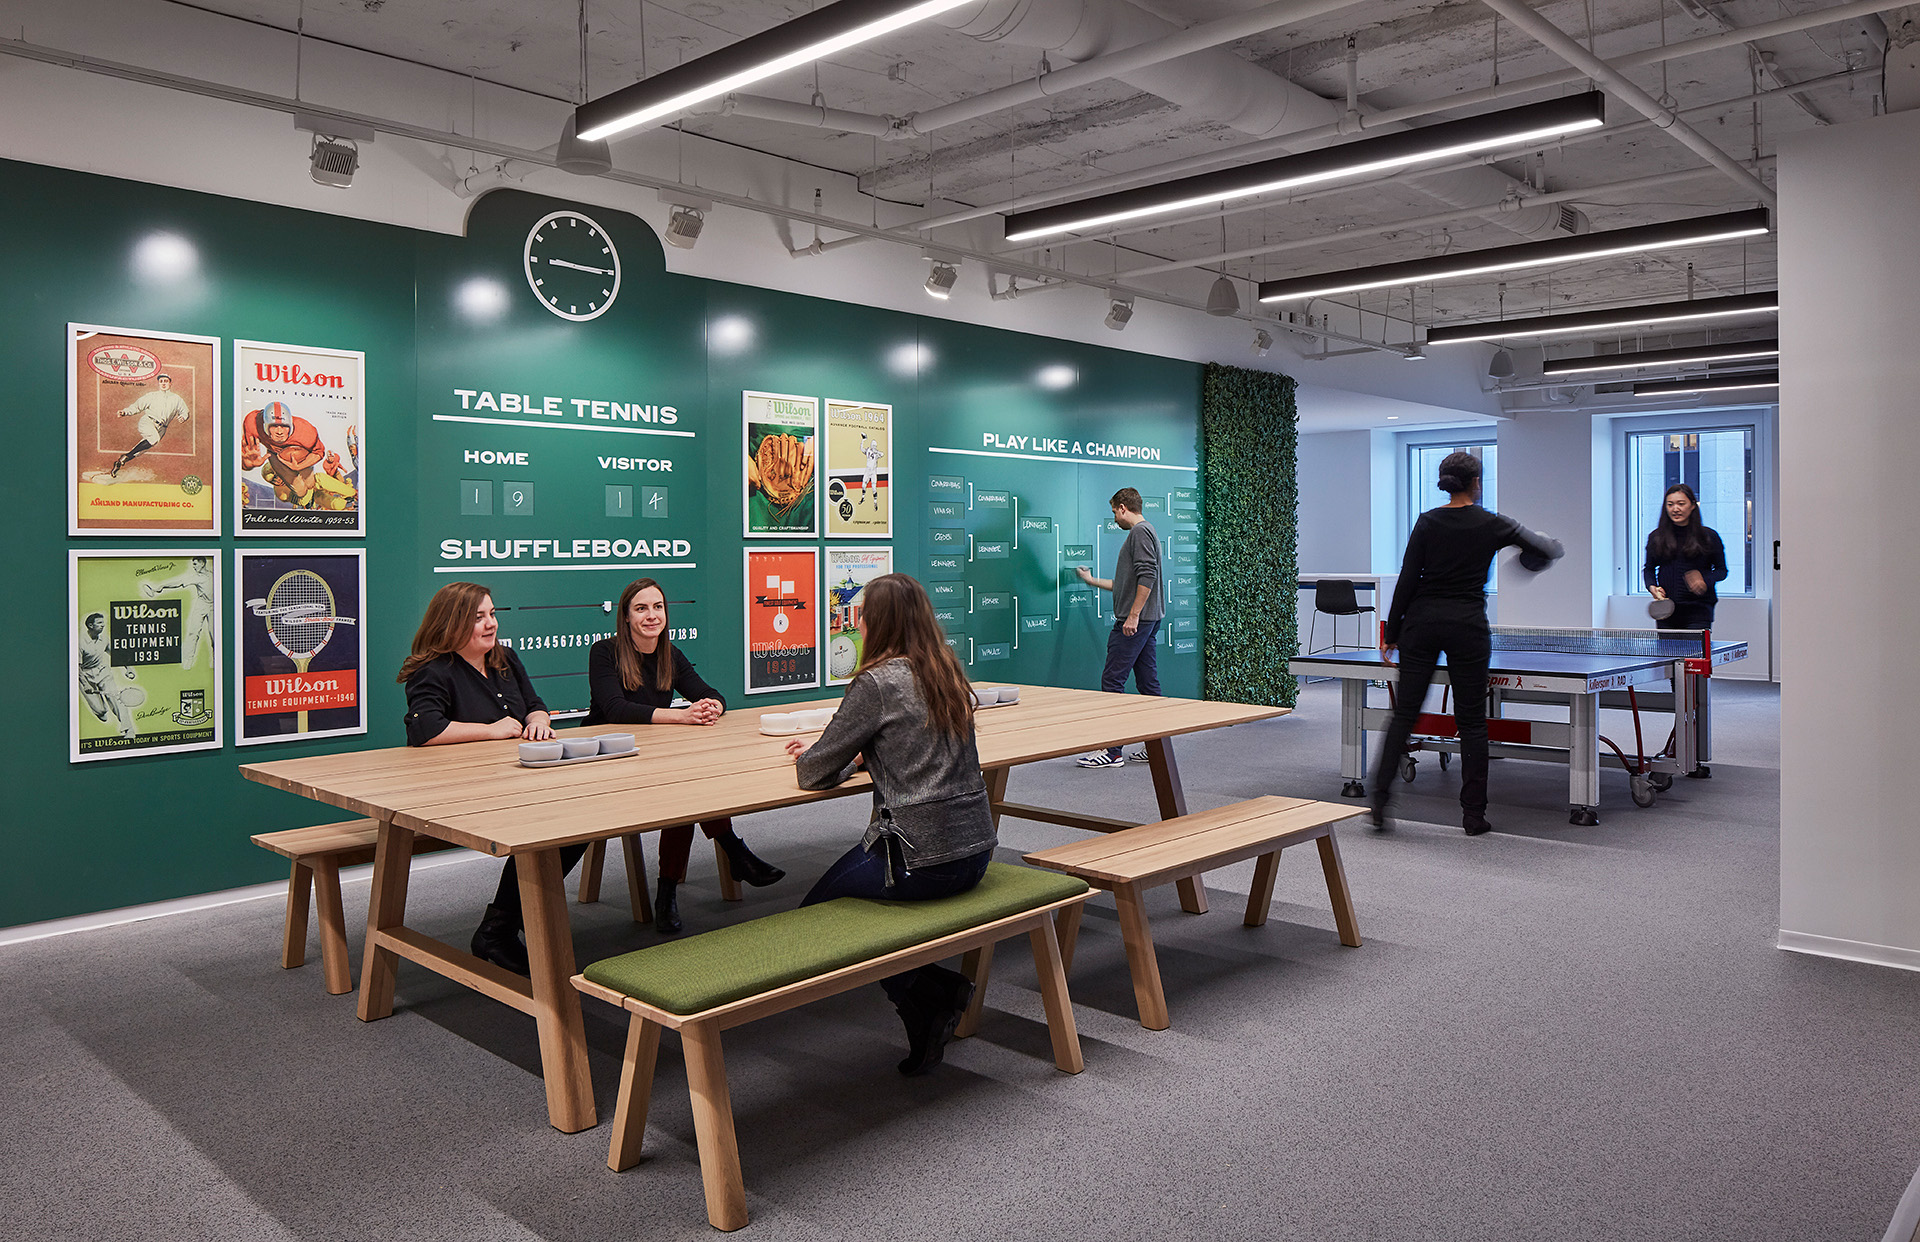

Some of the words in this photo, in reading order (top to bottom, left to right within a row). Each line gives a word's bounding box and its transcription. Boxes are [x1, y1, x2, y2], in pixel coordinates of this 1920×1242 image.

[255, 362, 344, 389] Wilson
[245, 387, 285, 395] SPORTS
[294, 391, 353, 400] EQUIPMENT
[454, 388, 563, 416] TABLE
[570, 398, 678, 425] TENNIS
[773, 401, 811, 416] Wilson
[831, 408, 863, 421] Wilson
[864, 411, 885, 424] 1964
[983, 432, 1029, 450] PLAY
[1032, 437, 1069, 454] LIKE
[1071, 441, 1083, 455] A
[1086, 441, 1161, 461] CHAMPION
[464, 449, 529, 466] HOME
[597, 456, 673, 472] VISITOR
[90, 498, 121, 507] ASHLAND
[122, 500, 181, 508] MANUFACTURING
[512, 490, 524, 507] 9
[648, 492, 663, 510] 4
[244, 513, 267, 524] Fall
[267, 515, 289, 524] and
[289, 515, 323, 524] Winter
[440, 538, 692, 560] SHUFFLEBOARD
[113, 603, 179, 620] Wilson
[126, 623, 167, 635] TENNIS
[113, 636, 180, 650] EQUIPMENT
[519, 637, 525, 650] 1
[527, 636, 534, 650] 2
[535, 636, 542, 649] 3
[543, 635, 551, 649] 4
[552, 635, 559, 648] 5
[560, 634, 567, 648] 6
[568, 634, 574, 647] 7
[576, 634, 582, 647] 8
[584, 633, 590, 646] 9
[591, 633, 602, 645] 10
[677, 628, 687, 640] 18
[688, 627, 698, 640] 19
[134, 650, 159, 662] 1939
[752, 638, 811, 659] Wilson
[265, 677, 340, 695] Wilson
[1616, 675, 1627, 686] RAD
[247, 699, 278, 709] TENNIS
[94, 736, 131, 748] Wilson
[160, 734, 181, 742] SPORTS
[182, 731, 213, 740] EQUIPMENT
